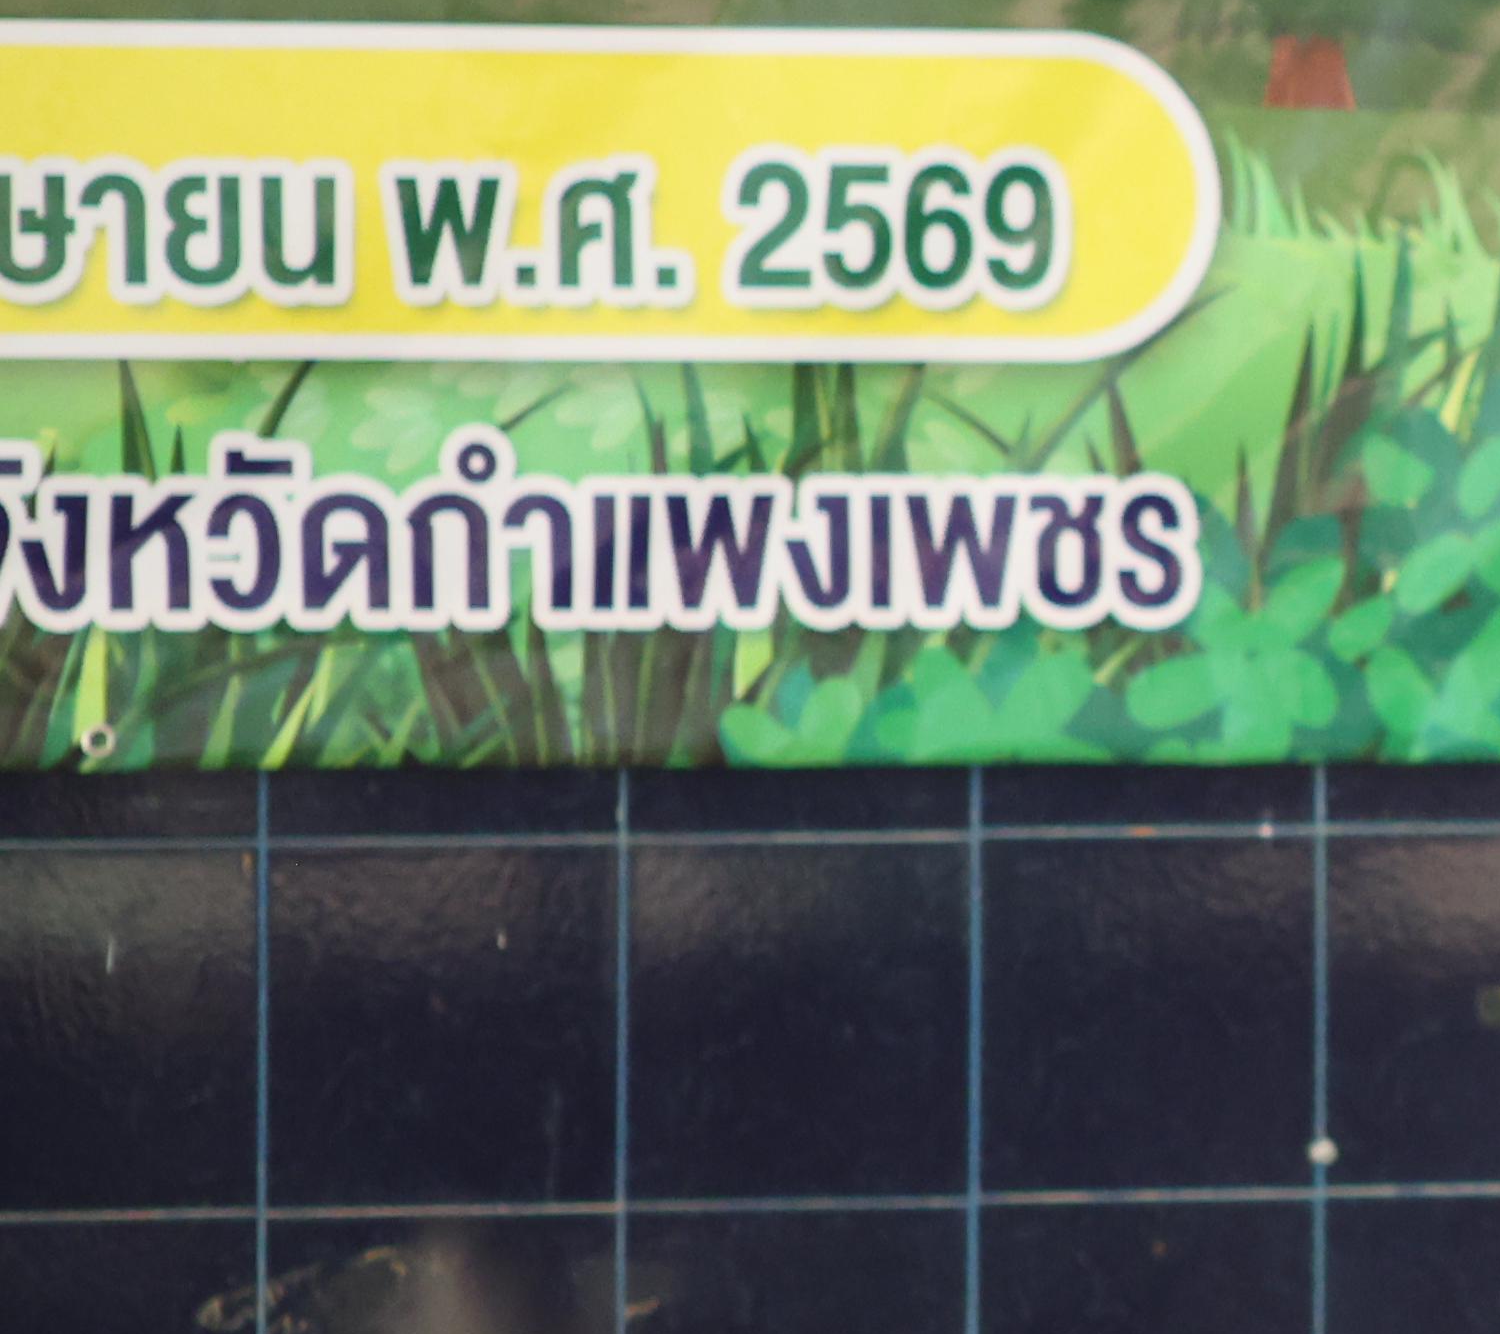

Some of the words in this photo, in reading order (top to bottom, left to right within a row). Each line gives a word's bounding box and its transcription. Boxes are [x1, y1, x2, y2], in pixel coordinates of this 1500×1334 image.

[396, 169, 678, 288] พ.ศ.
[738, 162, 1055, 290] 2569
[0, 443, 1183, 612] งหวัดกำแพงเพชร
